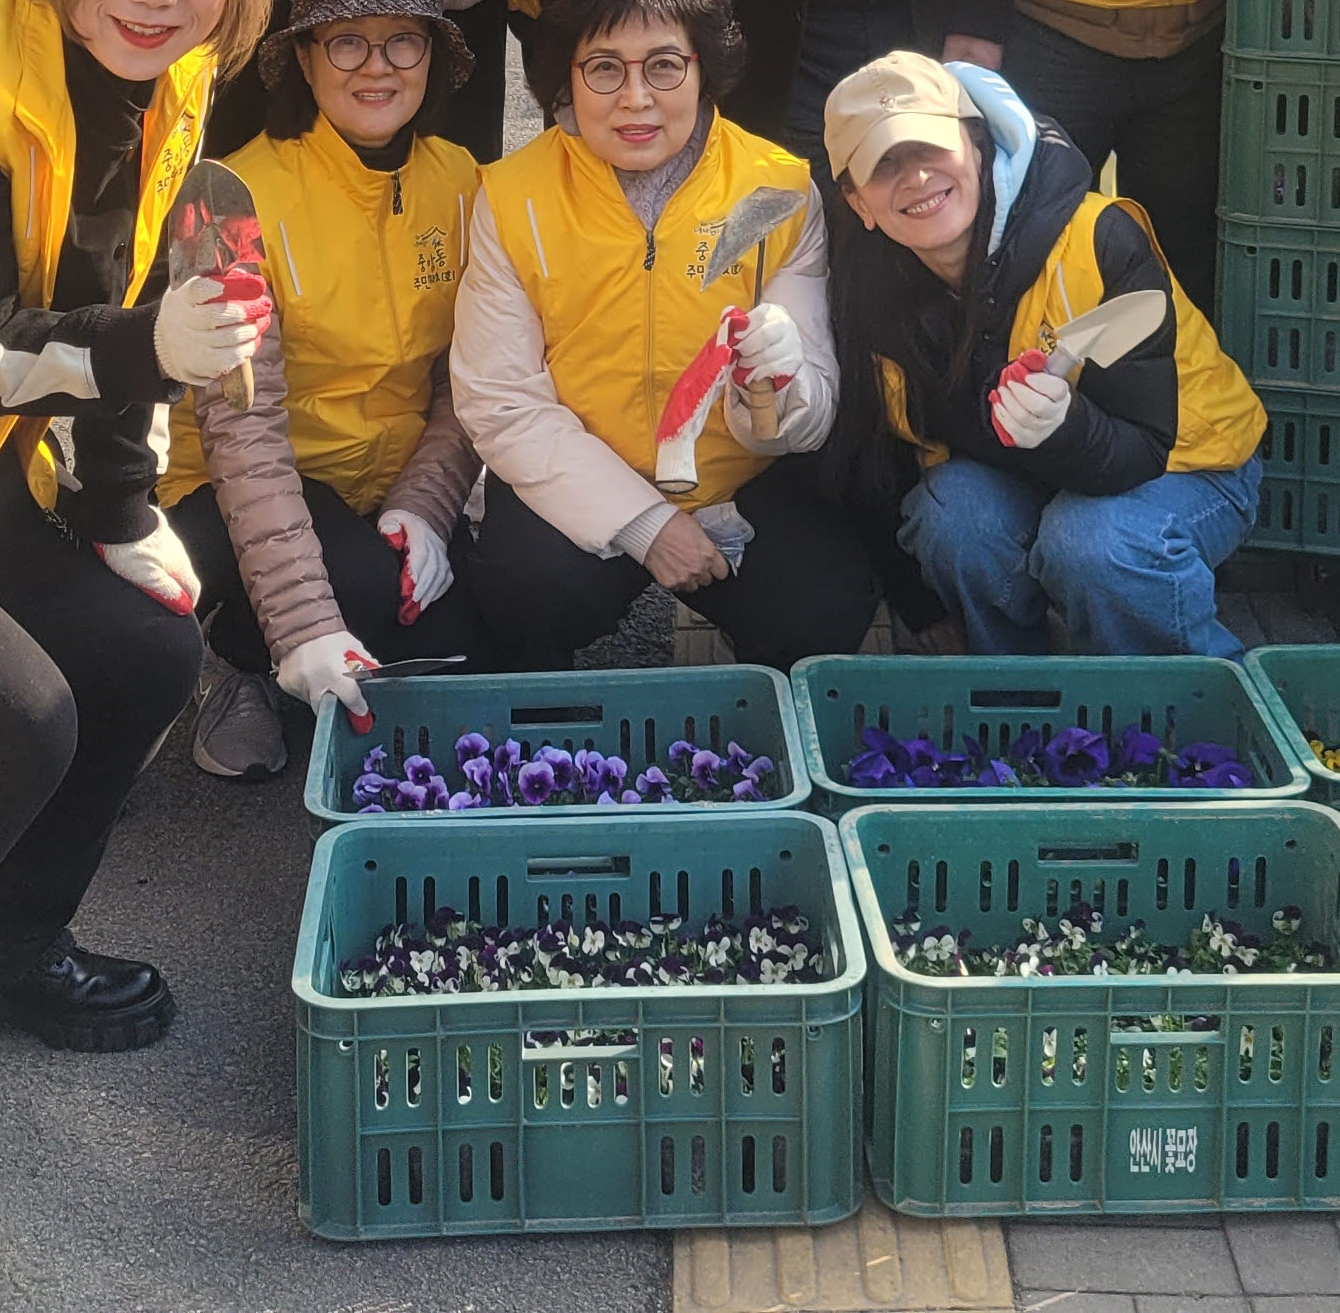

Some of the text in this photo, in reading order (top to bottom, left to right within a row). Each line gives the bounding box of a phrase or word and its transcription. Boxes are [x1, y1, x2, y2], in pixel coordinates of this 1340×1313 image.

[418, 247, 447, 273] 중앙동
[1129, 1126, 1198, 1174] 안산시 꽃묘장
